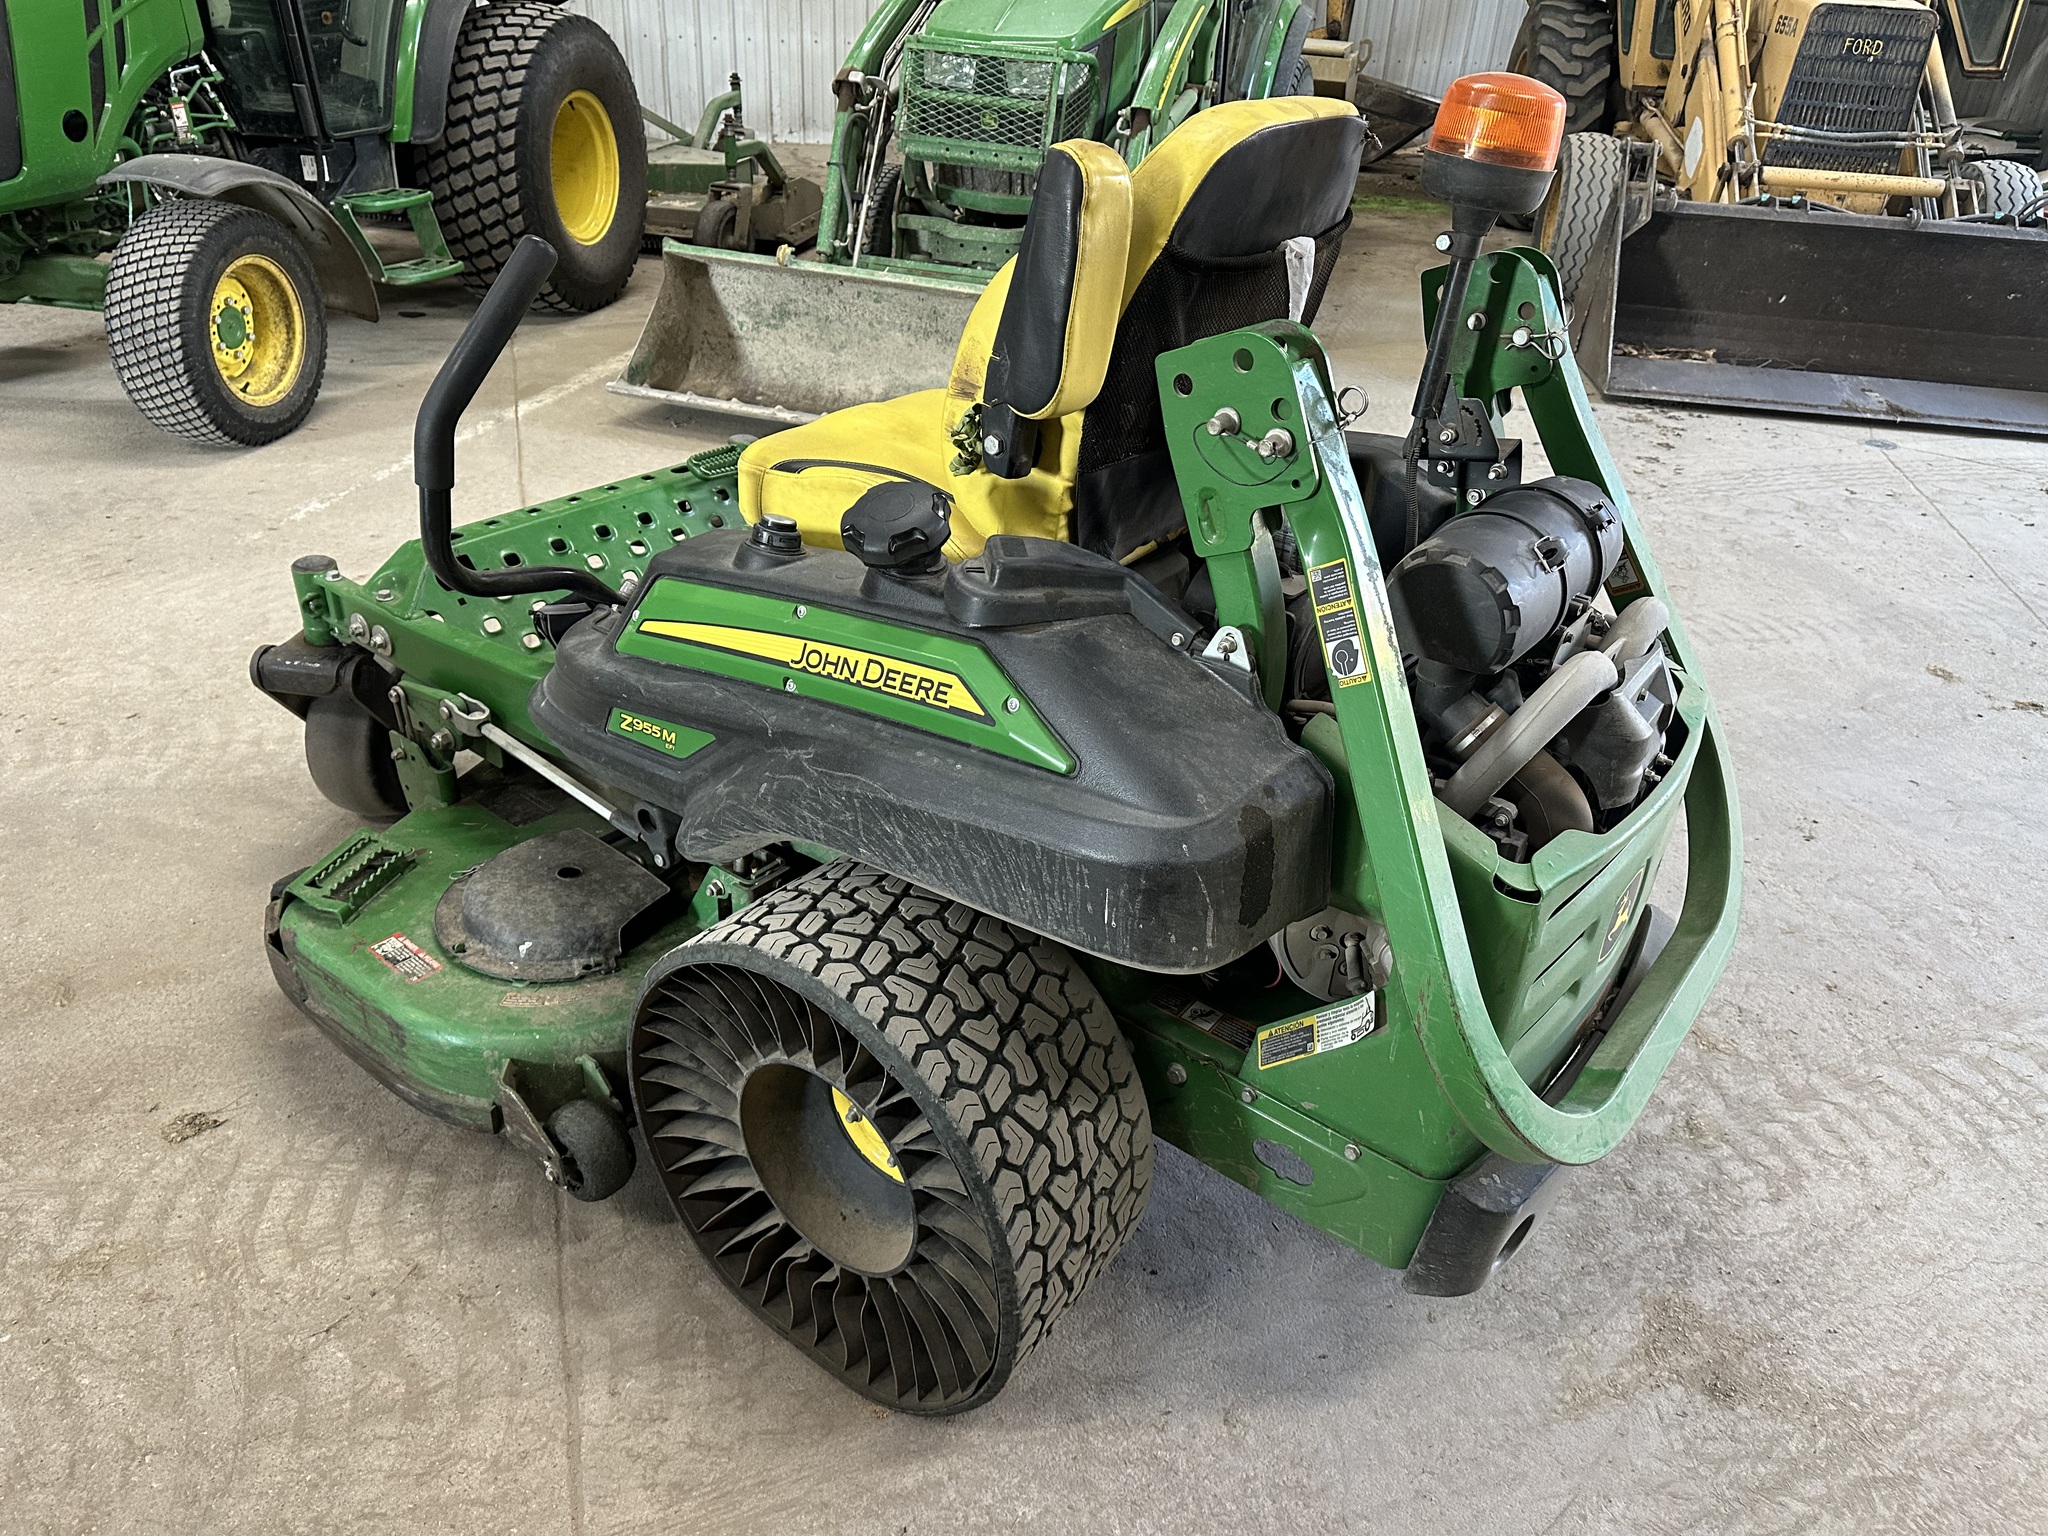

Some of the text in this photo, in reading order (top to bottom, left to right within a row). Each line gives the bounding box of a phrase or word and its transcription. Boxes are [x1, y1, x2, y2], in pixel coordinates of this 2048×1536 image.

[1774, 14, 1799, 38] 655A
[1842, 37, 1884, 55] FORD
[790, 642, 953, 704] JOHN DEERE
[1339, 676, 1364, 687] CAUTIO
[1274, 1020, 1304, 1035] ATENCIÓN
